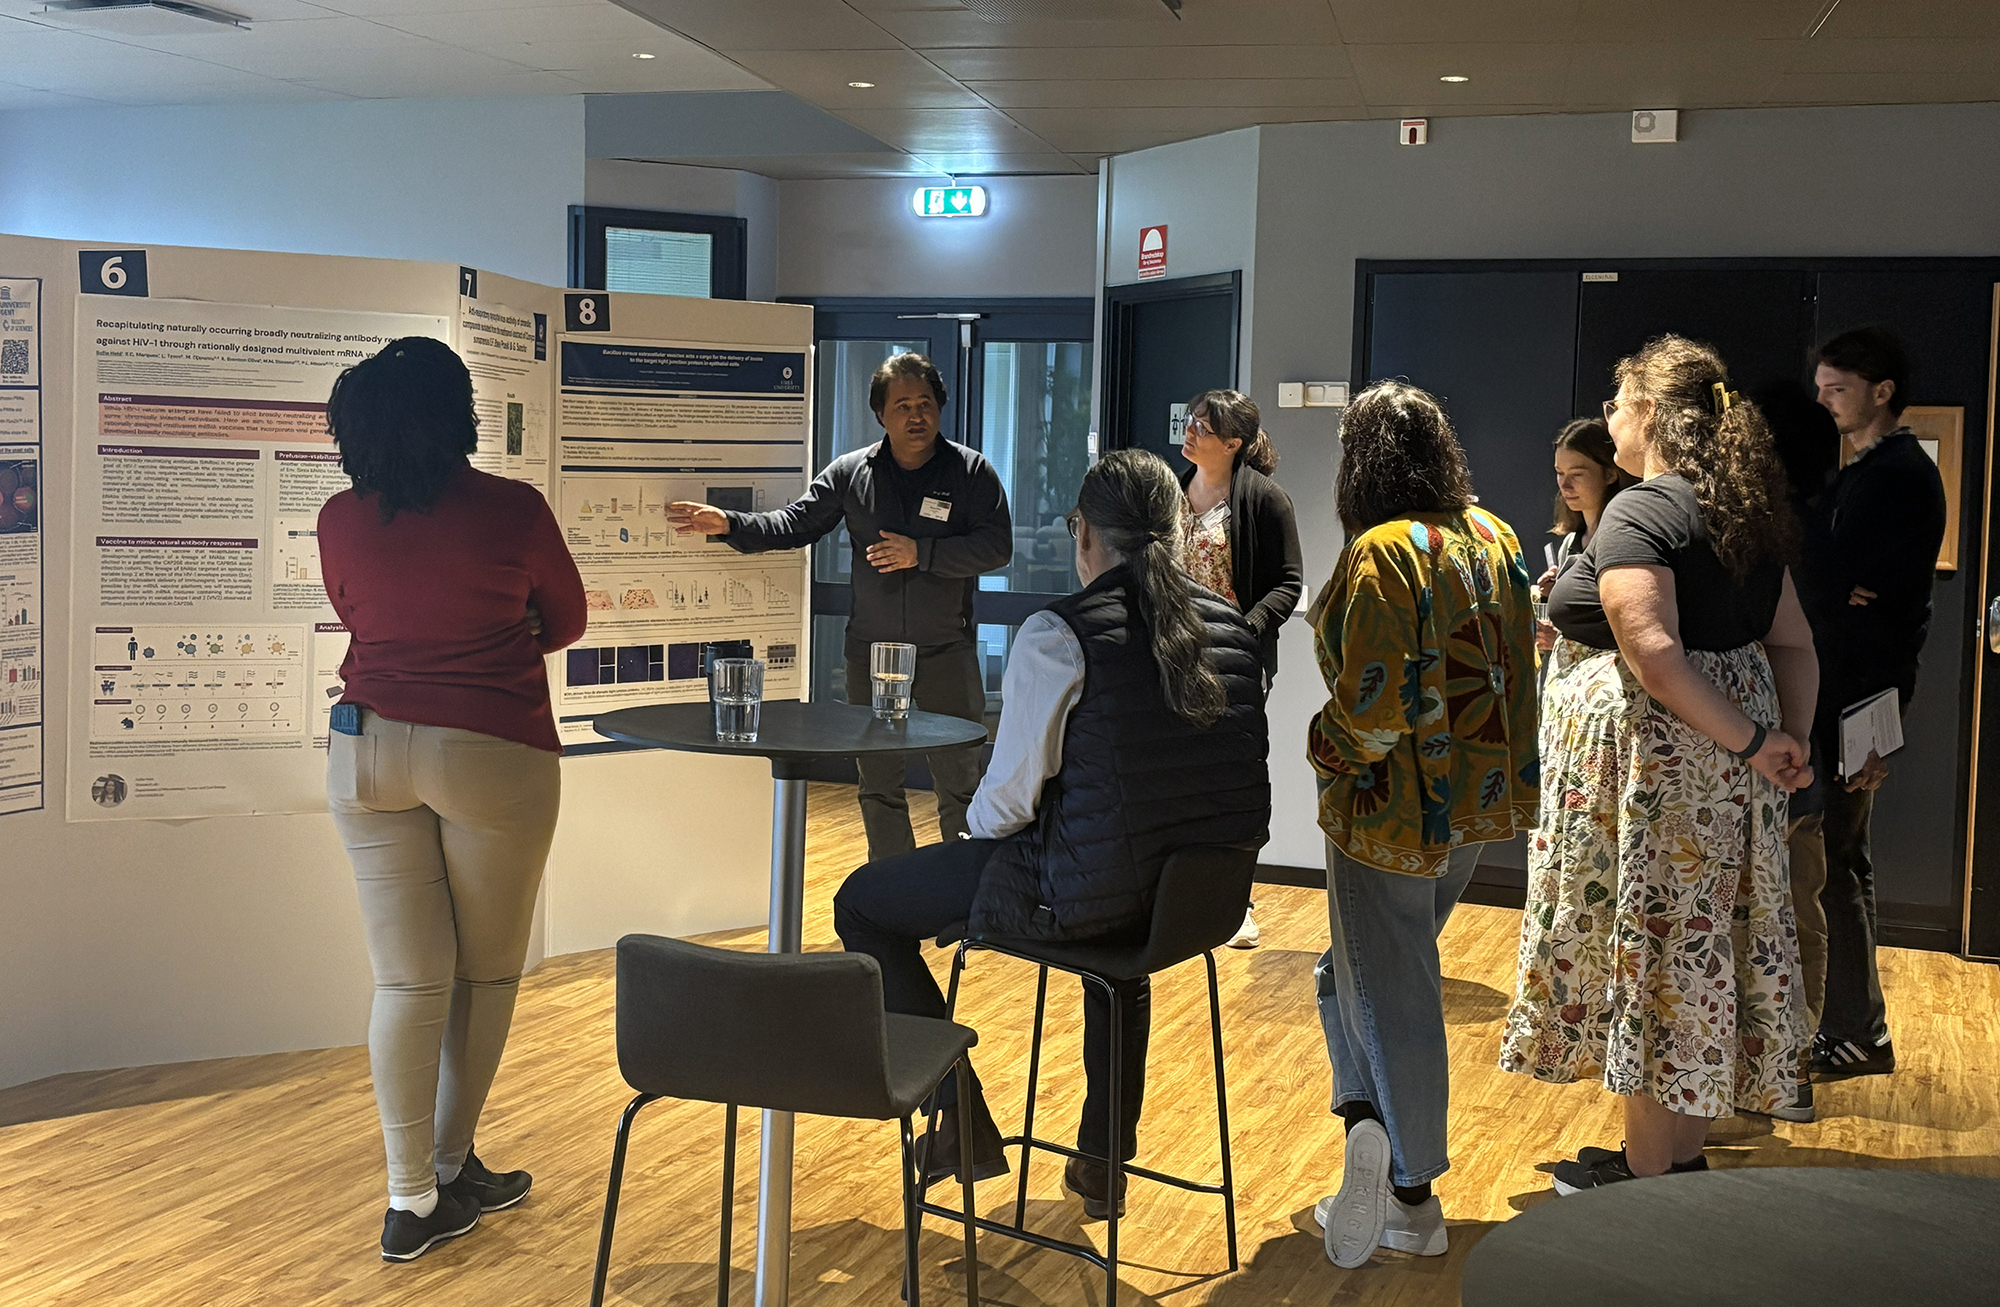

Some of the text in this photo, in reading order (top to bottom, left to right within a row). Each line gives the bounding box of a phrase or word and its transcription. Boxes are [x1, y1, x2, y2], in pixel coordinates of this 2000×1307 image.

[100, 256, 128, 290] 6
[465, 273, 472, 297] 7
[579, 298, 597, 325] 8
[96, 319, 164, 332] Recapitulating
[166, 324, 207, 335] naturally
[209, 327, 252, 338] occurring
[254, 328, 288, 339] broadly
[290, 330, 341, 342] neutralizing
[343, 334, 382, 343] antibody
[96, 337, 130, 346] against
[133, 338, 157, 346] HIV-1
[159, 340, 196, 350] through
[198, 341, 240, 352] rationally
[242, 344, 283, 354] designed
[285, 347, 335, 356] multivalent
[259, 411, 281, 419] broadly
[283, 412, 315, 420] neutralizing
[260, 425, 293, 434] incorporate
[181, 539, 208, 547] antibody
